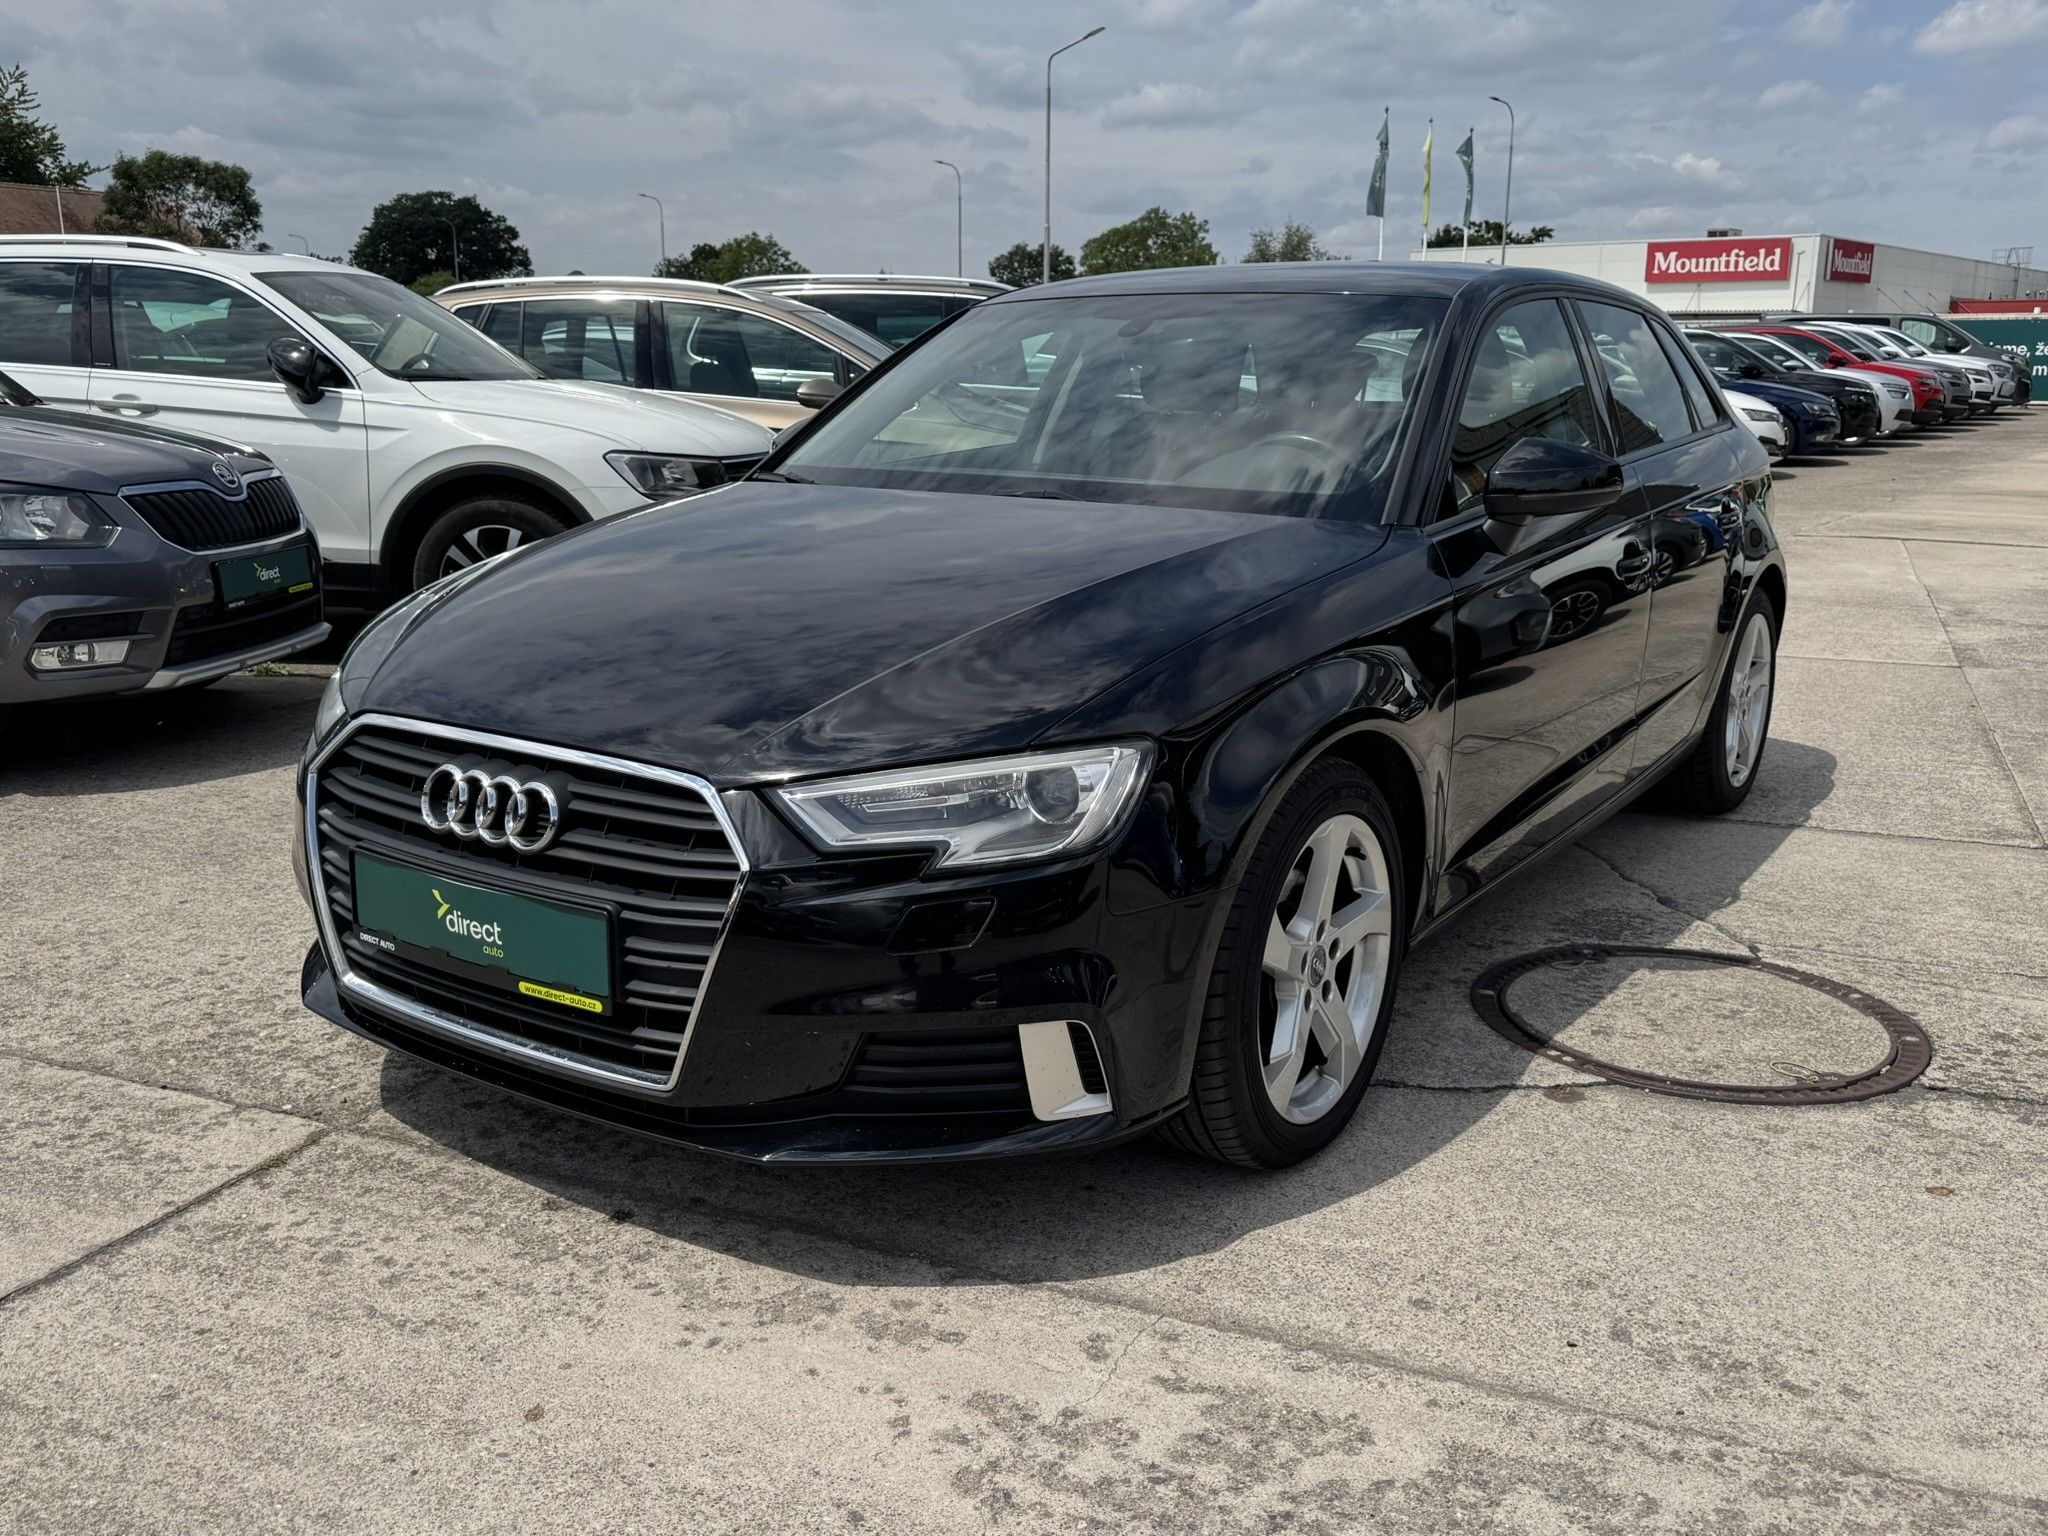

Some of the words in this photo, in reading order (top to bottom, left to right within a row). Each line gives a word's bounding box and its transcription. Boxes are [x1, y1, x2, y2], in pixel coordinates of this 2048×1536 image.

[1652, 248, 1781, 274] Mountfield
[1832, 249, 1871, 275] Mountfield
[260, 567, 280, 580] direct
[445, 910, 502, 945] direct
[359, 932, 379, 945] DIRECT
[379, 939, 395, 951] AUTO
[482, 945, 504, 958] auto
[523, 984, 598, 1010] www.direct-auto.cz
